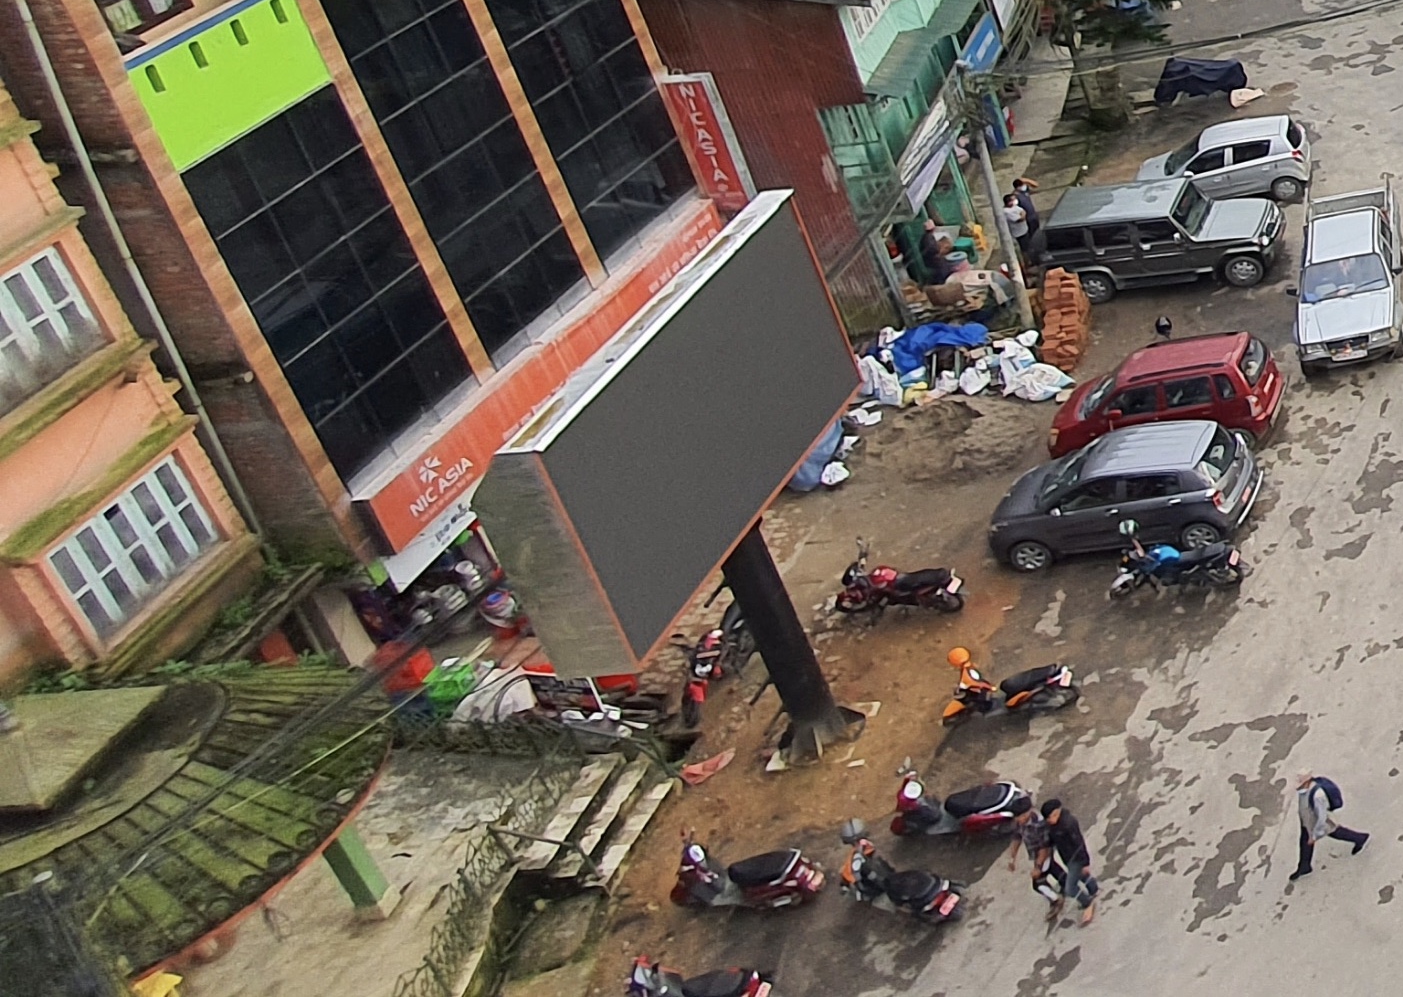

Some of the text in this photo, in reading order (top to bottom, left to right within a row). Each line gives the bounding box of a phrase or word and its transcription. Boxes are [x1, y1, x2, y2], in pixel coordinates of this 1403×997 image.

[697, 128, 729, 182] ASIA
[410, 486, 438, 517] NIC
[438, 457, 474, 494] ASIA
